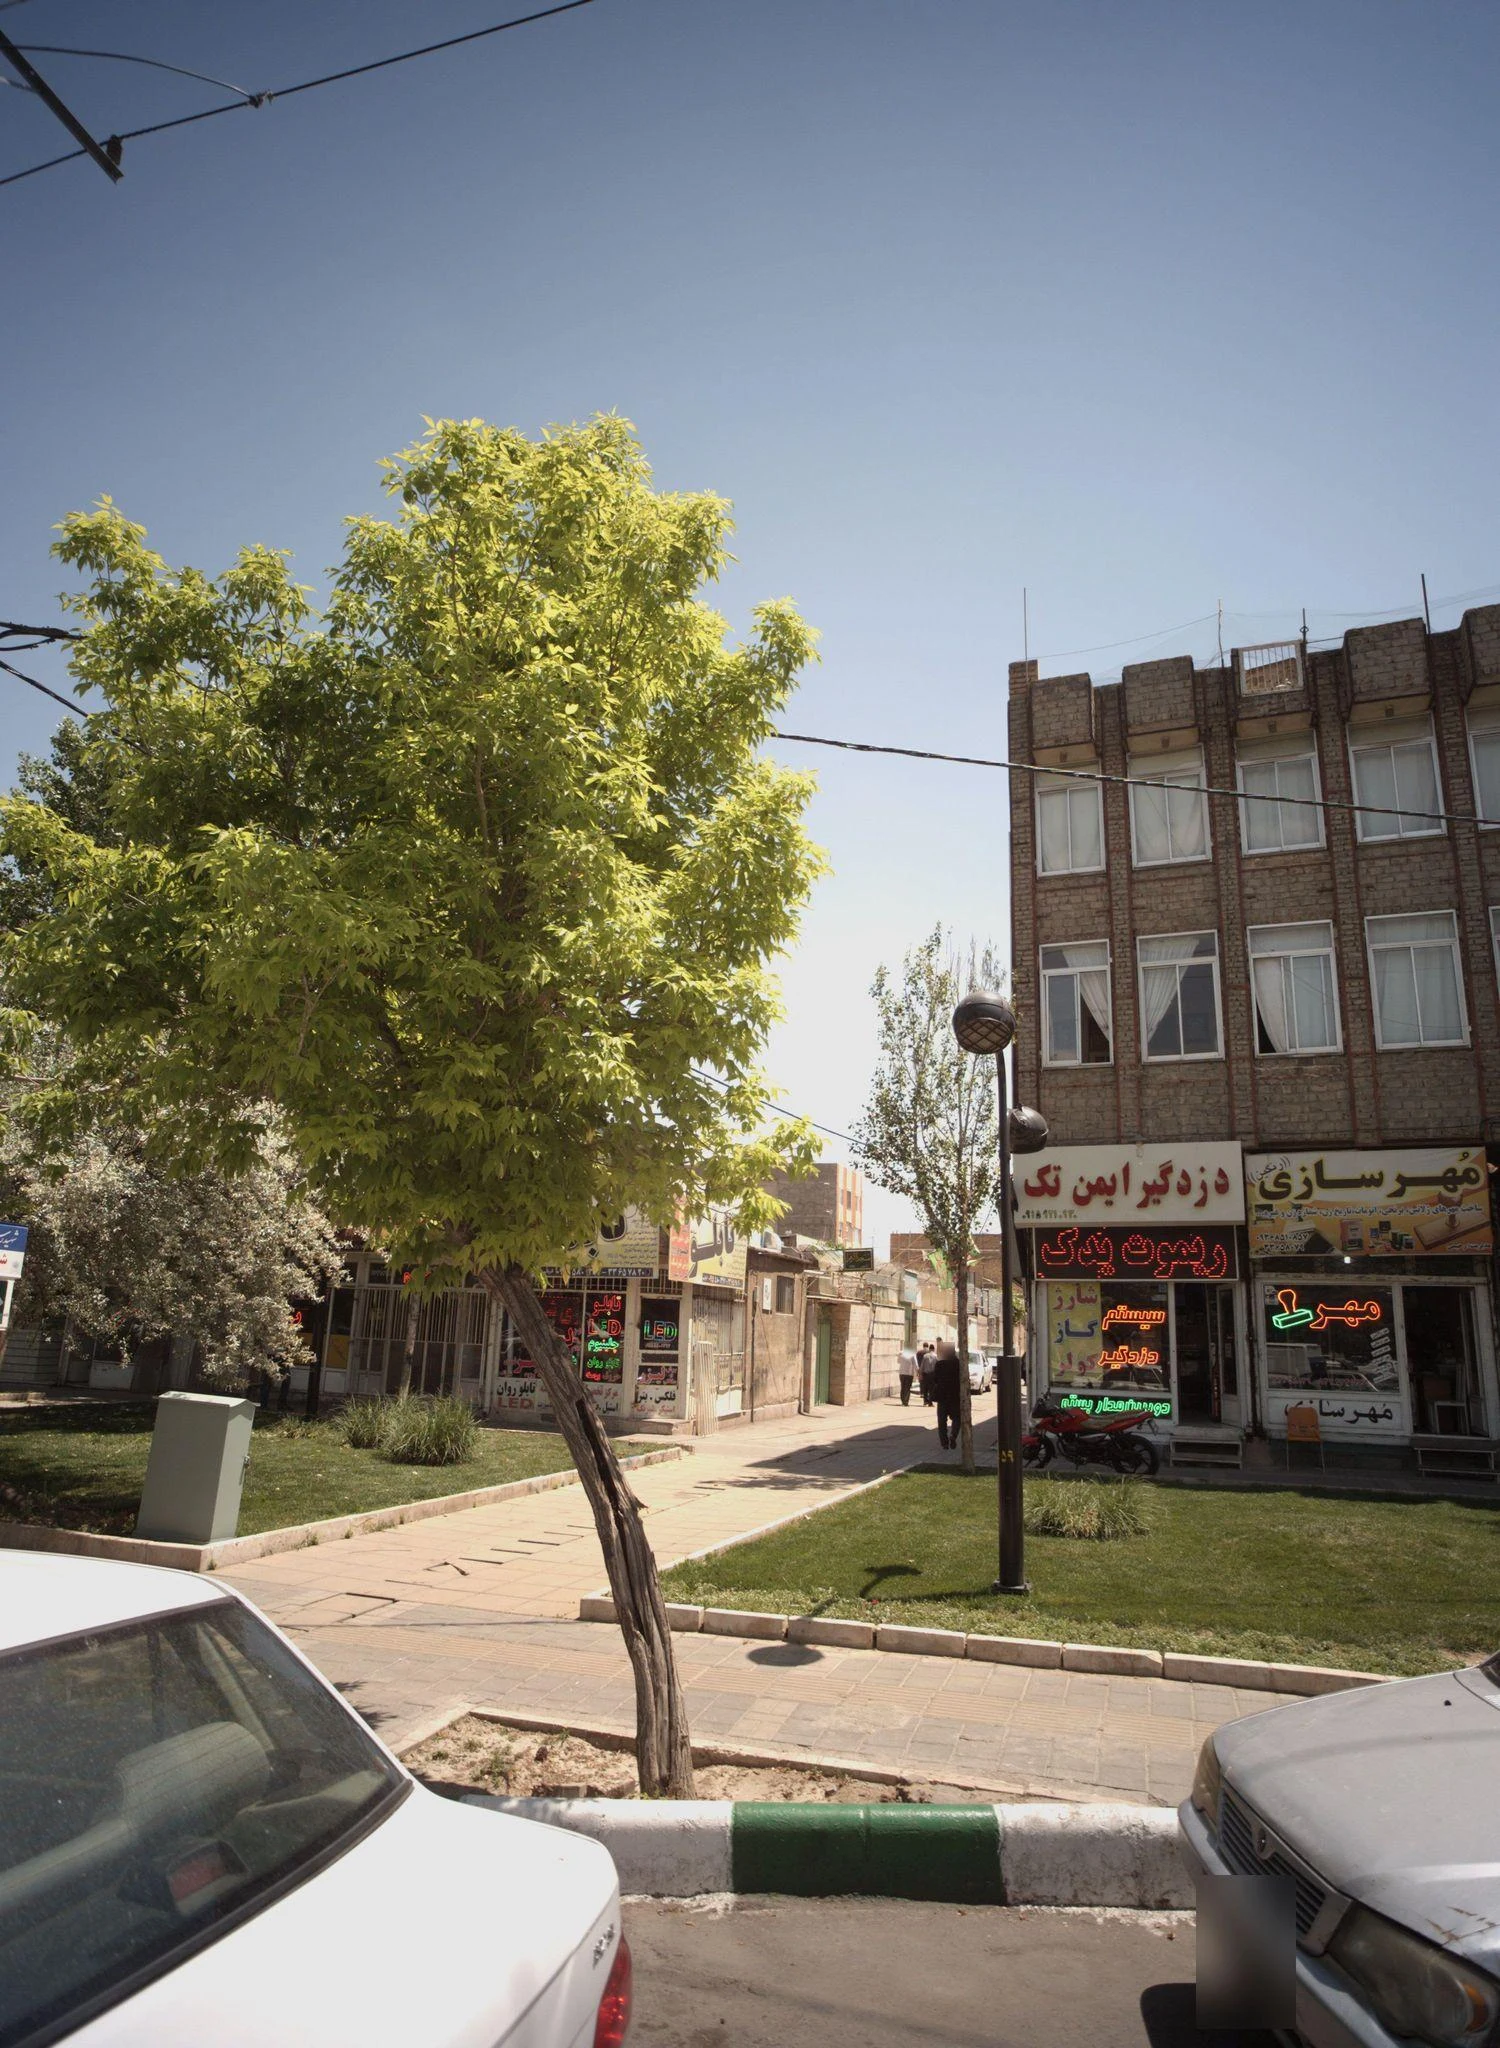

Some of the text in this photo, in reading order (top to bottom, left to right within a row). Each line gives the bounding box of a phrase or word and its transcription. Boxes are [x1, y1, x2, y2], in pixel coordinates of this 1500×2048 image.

[1024, 1160, 1230, 1208] دزدگیر ایمن تک
[1259, 1158, 1384, 1200] سازی
[1052, 1282, 1098, 1310] شارژ
[587, 1318, 622, 1336] LED
[1101, 1305, 1166, 1331] سیستم
[1309, 1300, 1381, 1329] مهر
[643, 1320, 678, 1341] LED
[1097, 1345, 1159, 1370] دزدگیر
[496, 1381, 536, 1397] تابلو روان
[497, 1397, 535, 1410] LED
